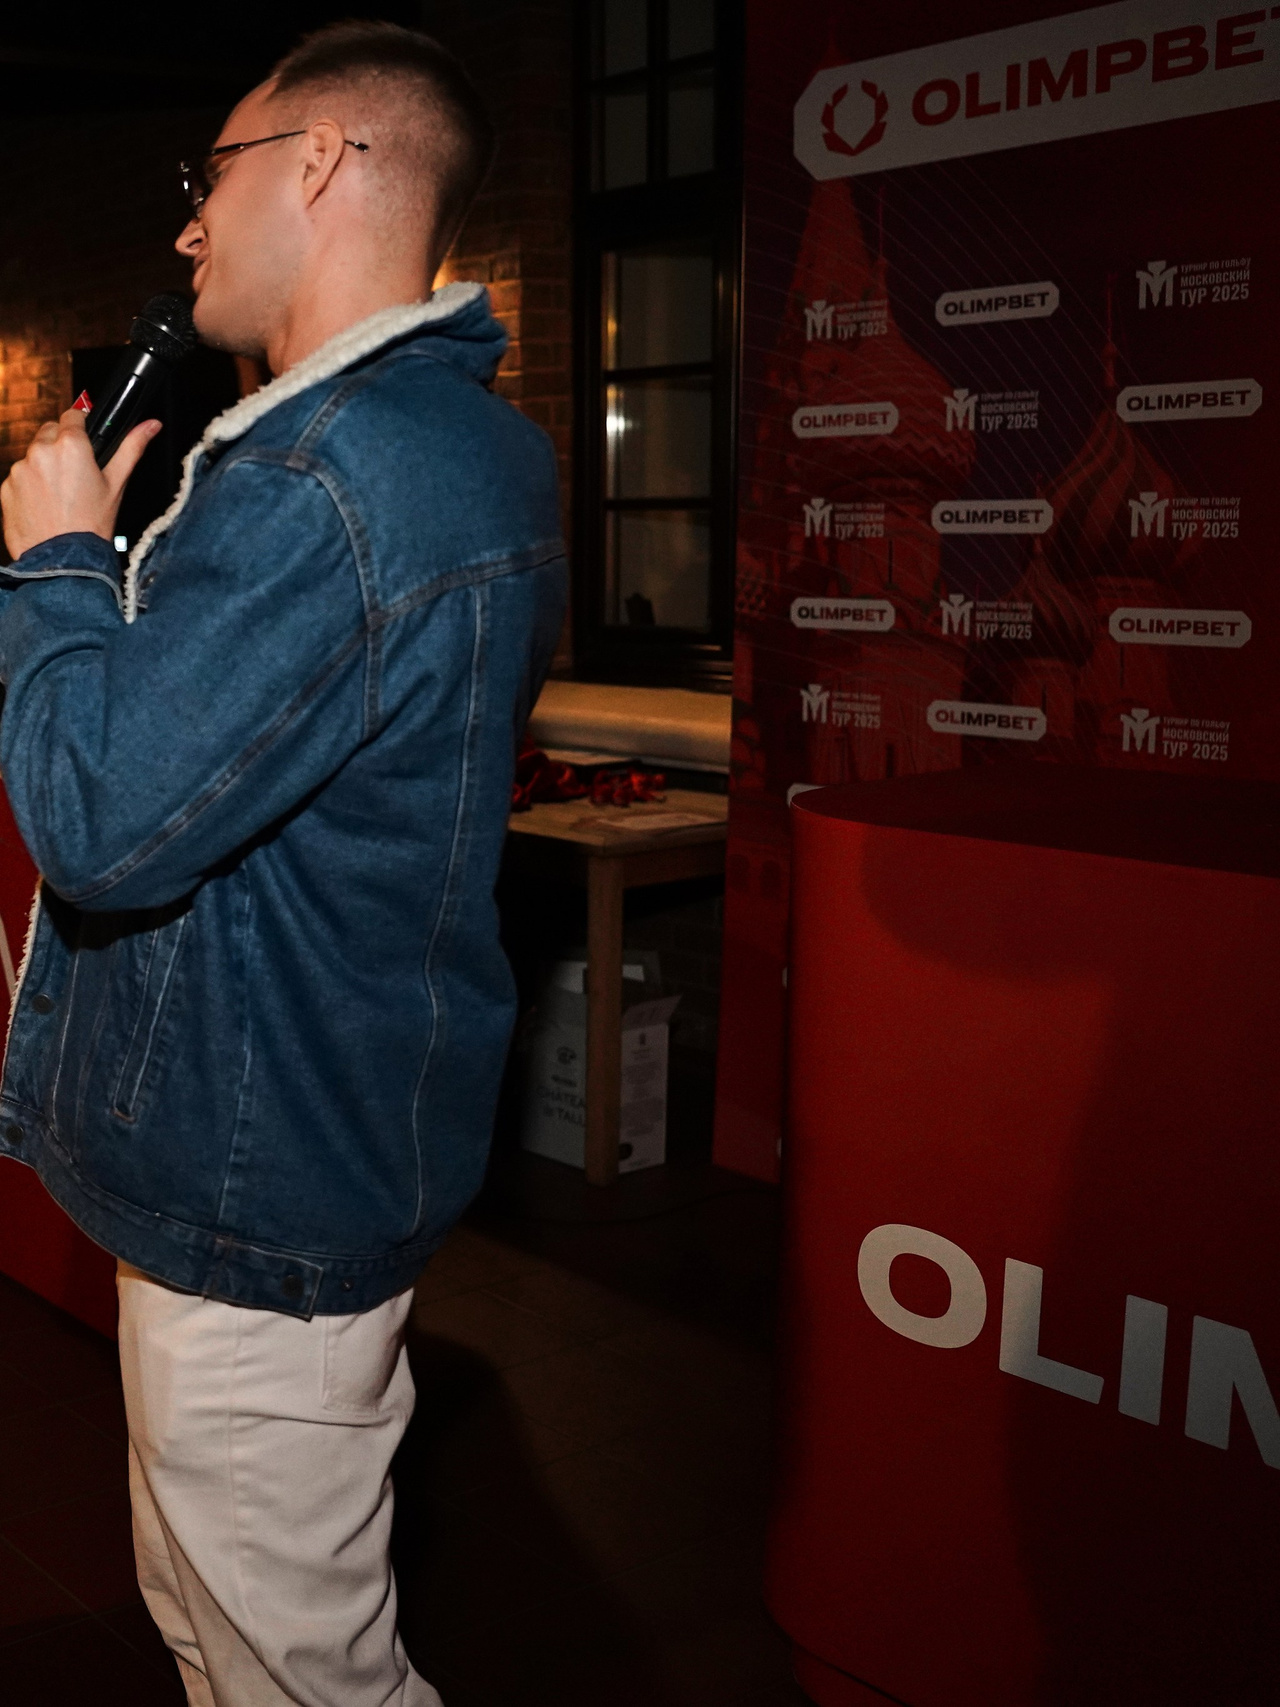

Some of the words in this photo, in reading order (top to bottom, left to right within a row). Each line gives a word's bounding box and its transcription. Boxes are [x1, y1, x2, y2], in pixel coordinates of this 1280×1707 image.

[912, 6, 1280, 126] OLIMPBE
[944, 291, 1050, 316] OLIMPBET
[1180, 288, 1207, 308] ТУР
[1212, 283, 1249, 302] 2025
[1126, 389, 1252, 412] OLIMPBET
[799, 411, 890, 429] OLIMPBET
[981, 415, 1003, 433] ТУР
[1007, 413, 1038, 429] 2025
[940, 509, 1044, 524] OLIMPBET
[1171, 522, 1198, 541] ТУР
[1202, 522, 1239, 538] 2025
[798, 606, 888, 622] OLIMPBET
[1001, 623, 1032, 640] 2025
[1118, 618, 1241, 637] OLIMPBET
[935, 709, 1038, 731] OLIMPBET
[1162, 740, 1188, 759] ТУР
[1192, 743, 1228, 761] 2025
